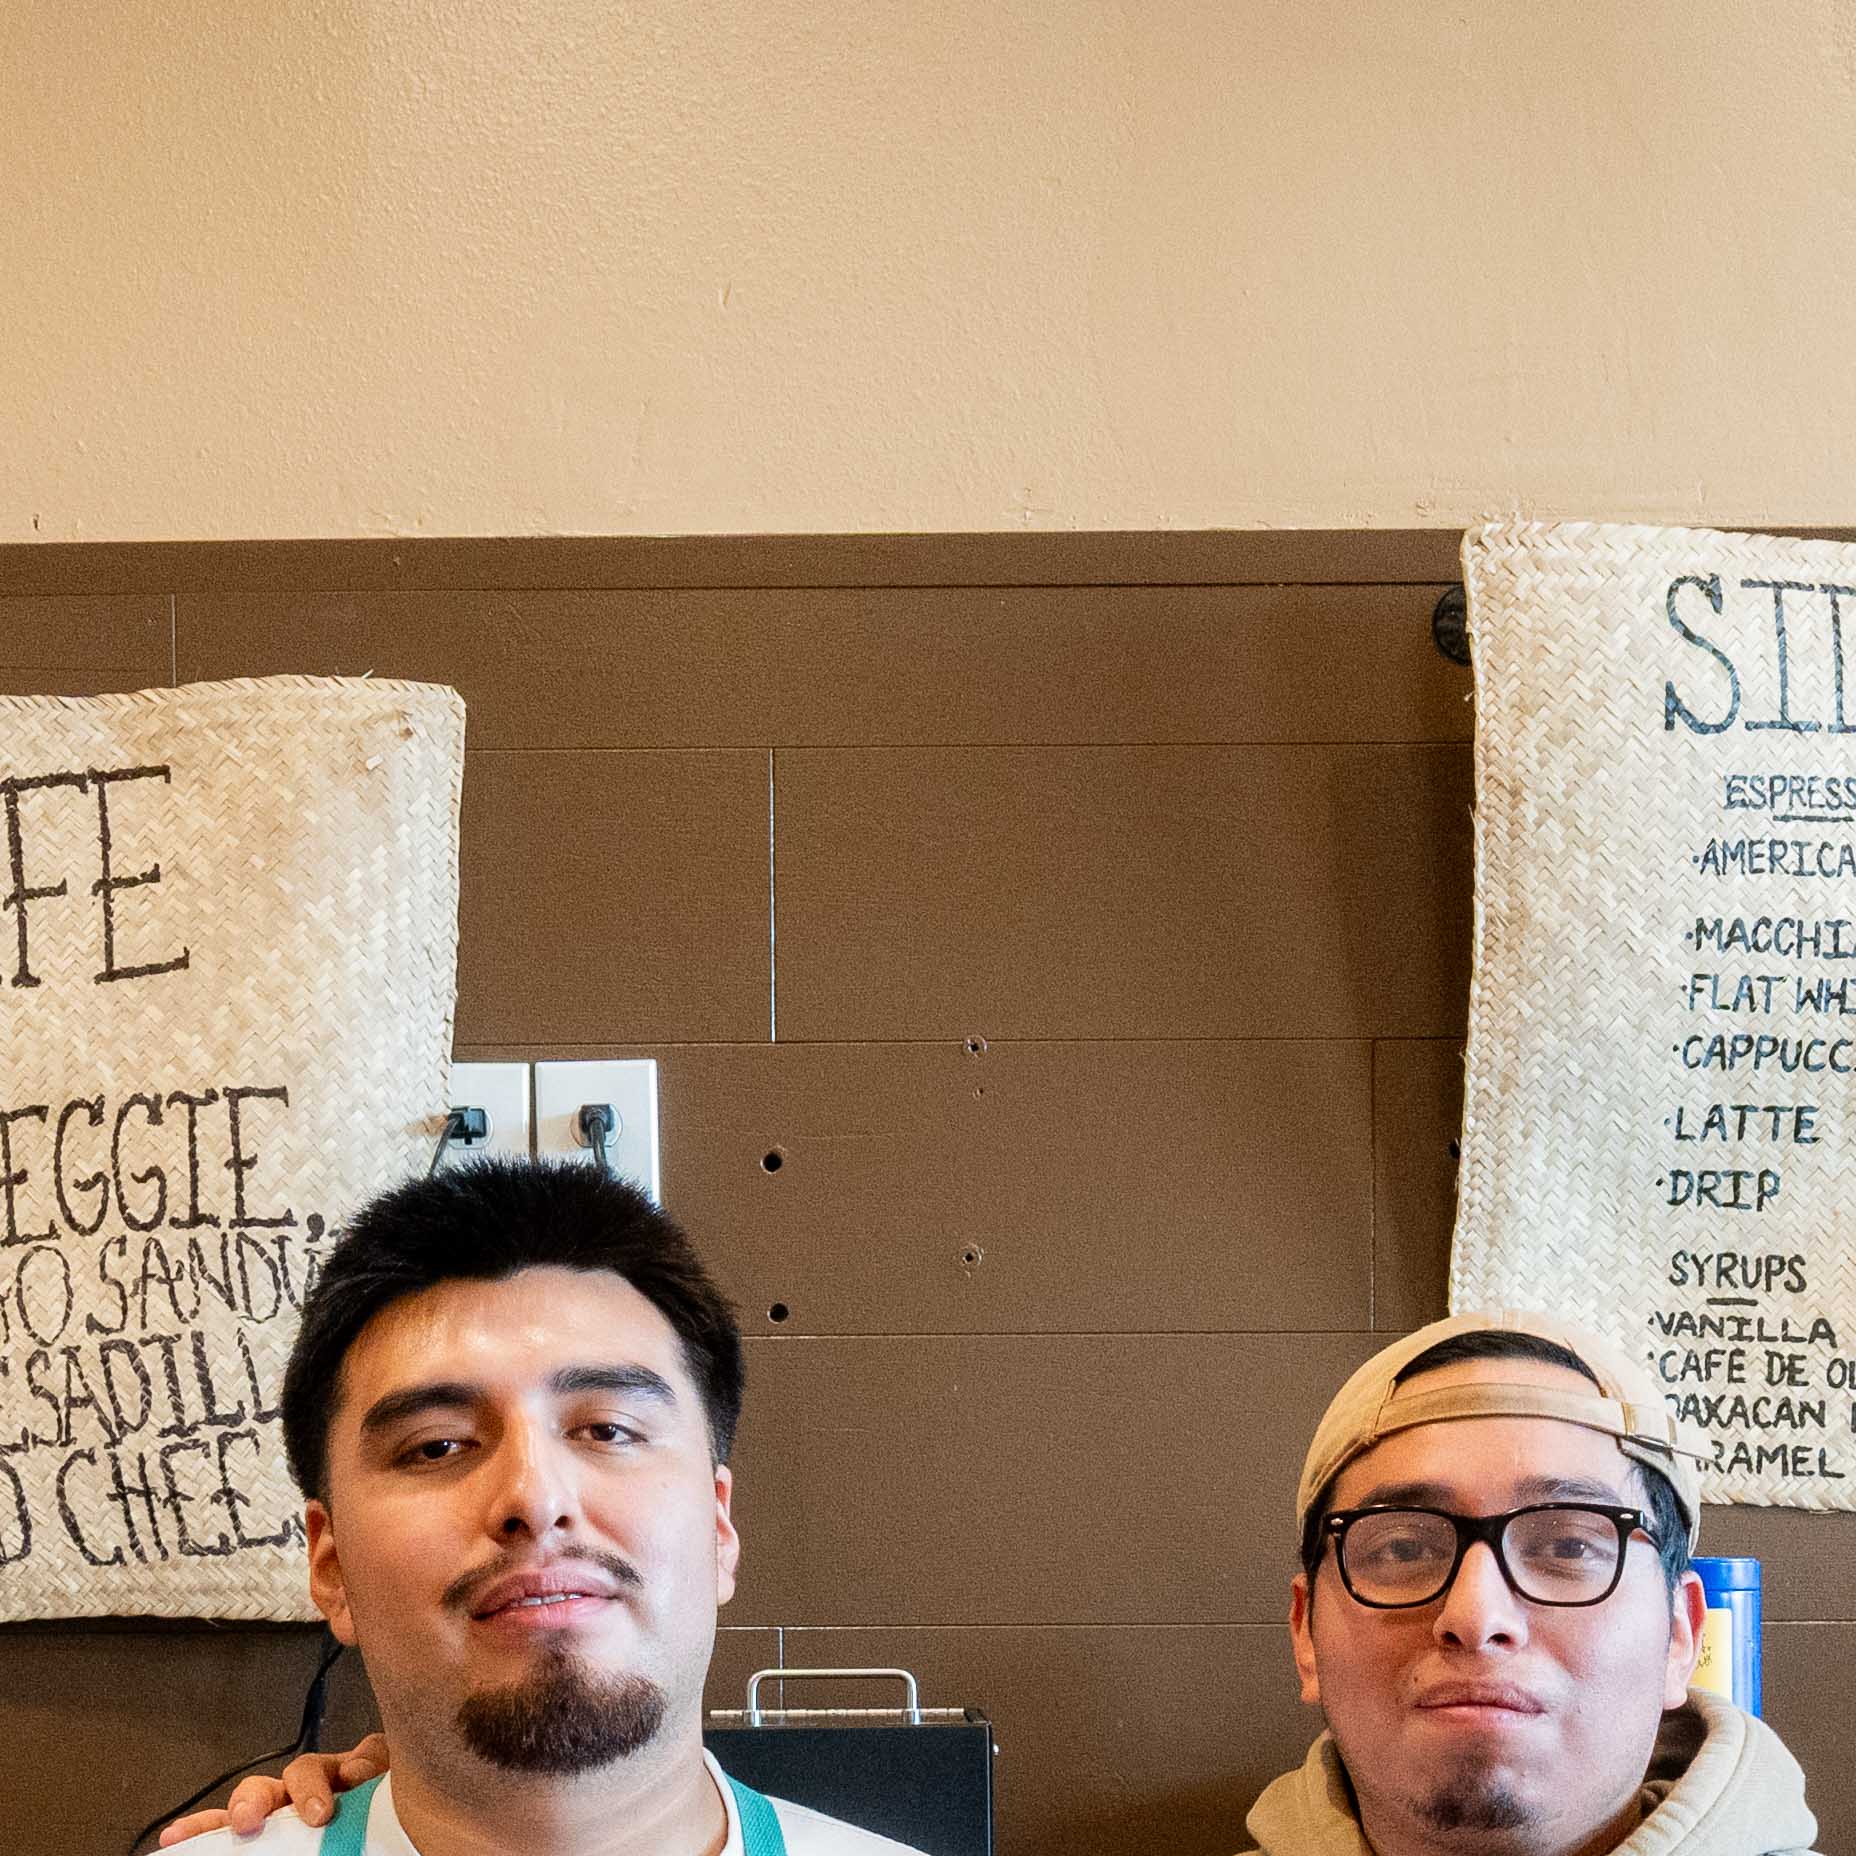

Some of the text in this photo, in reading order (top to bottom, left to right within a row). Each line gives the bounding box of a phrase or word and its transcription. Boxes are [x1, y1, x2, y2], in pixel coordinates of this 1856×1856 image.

[1688, 973, 1786, 1014] FLAT
[1676, 1104, 1820, 1143] LATTE
[1668, 1169, 1781, 1211] DRIP
[1669, 1250, 1807, 1294] SYRUPS
[1655, 1311, 1838, 1348] VANILLA
[1660, 1349, 1746, 1384] CAFE
[1766, 1350, 1809, 1387] DE
[1695, 1440, 1845, 1478] RAMEL
[56, 1429, 306, 1566] CHEE
